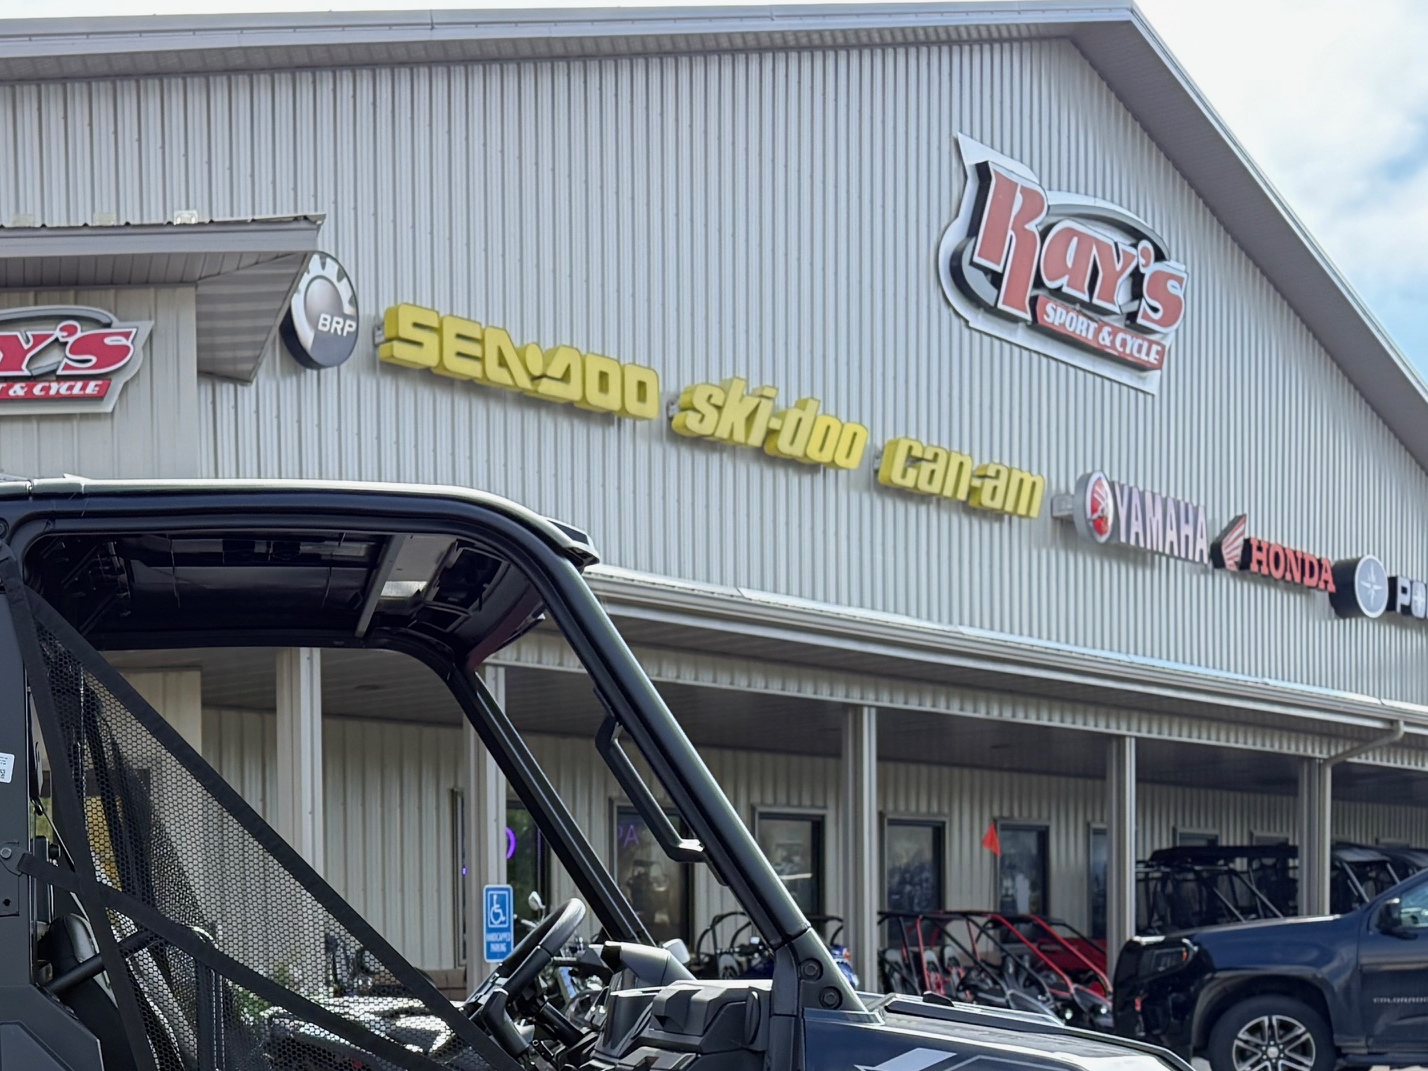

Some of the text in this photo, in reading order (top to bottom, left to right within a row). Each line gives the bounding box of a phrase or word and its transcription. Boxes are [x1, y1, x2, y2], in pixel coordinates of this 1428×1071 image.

[317, 313, 356, 338] BRP
[1044, 303, 1162, 365] SPORT & CYCLE
[9, 382, 29, 398] &
[32, 380, 104, 398] CYCLE
[1115, 481, 1209, 565] YAMAHA
[1249, 537, 1336, 594] HONDA
[1396, 576, 1428, 620] PO
